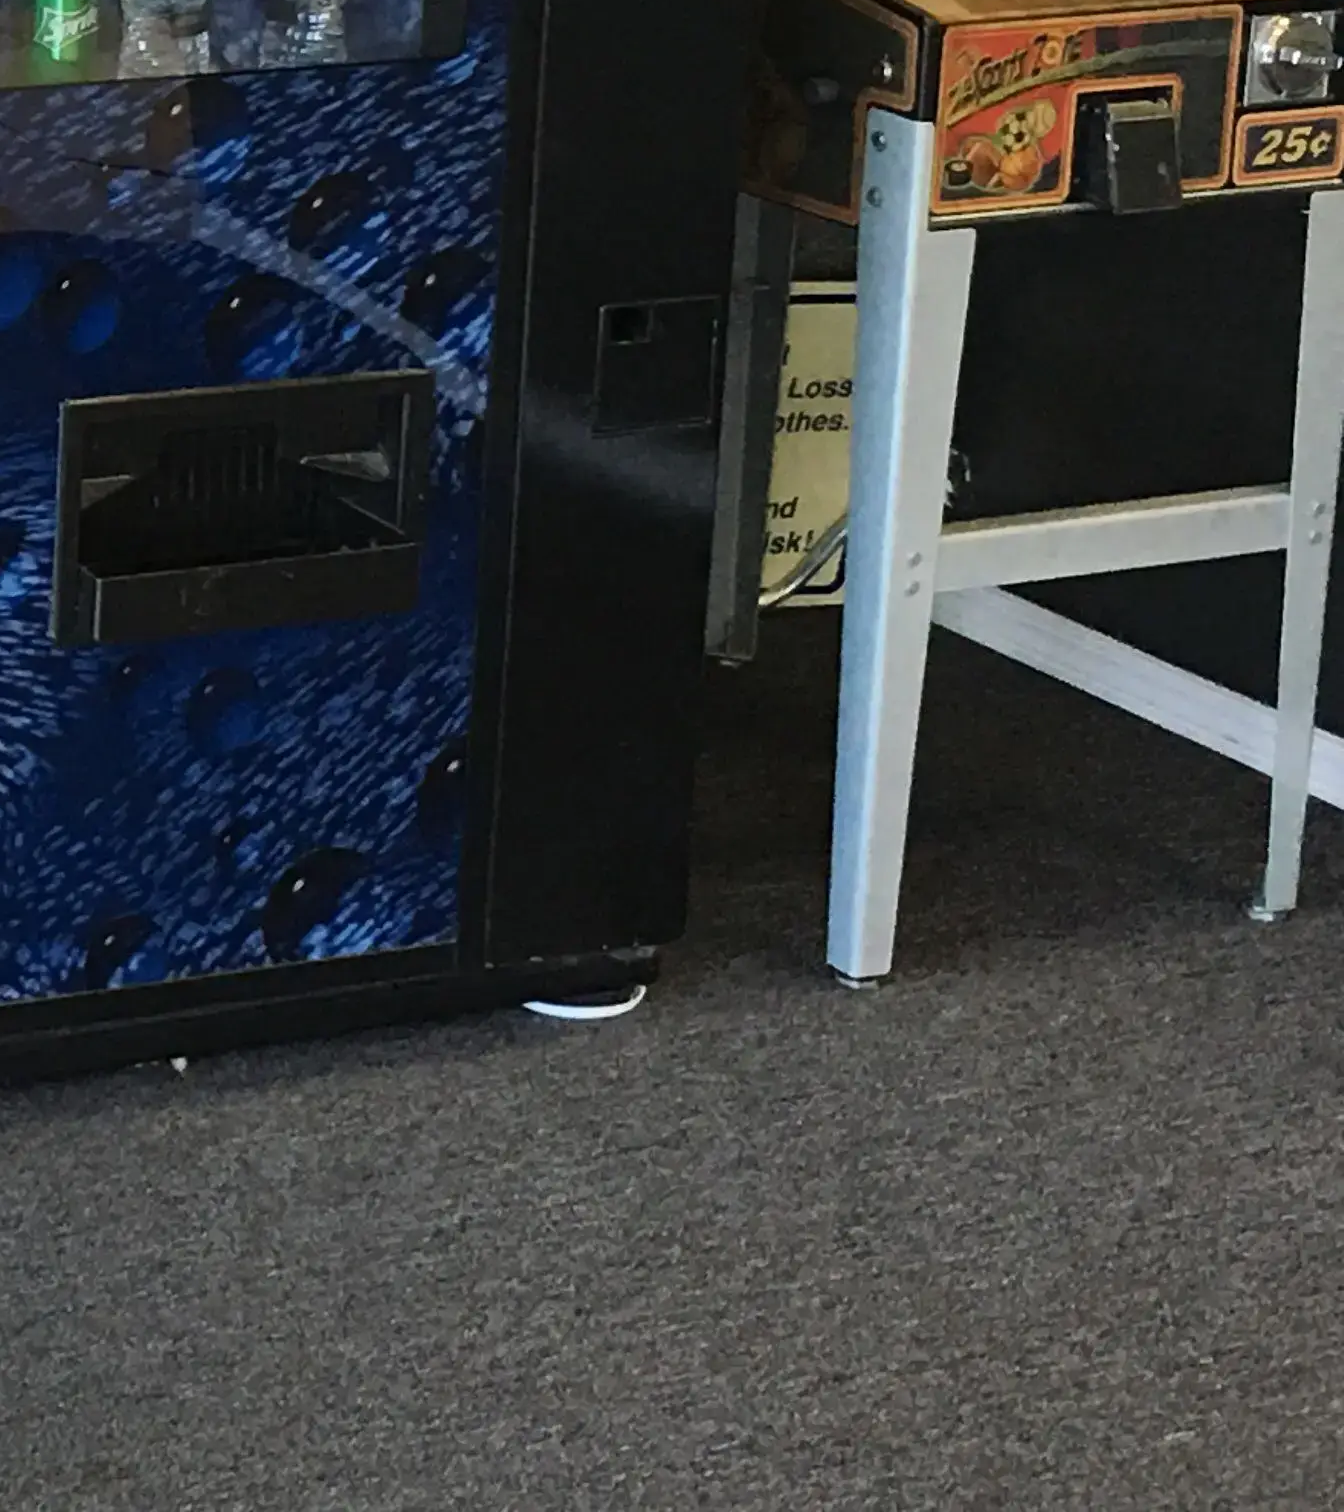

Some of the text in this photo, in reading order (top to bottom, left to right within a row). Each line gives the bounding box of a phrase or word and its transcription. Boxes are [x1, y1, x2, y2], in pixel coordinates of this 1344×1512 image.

[1252, 126, 1333, 167] 25¢
[787, 377, 853, 399] Loss
[776, 411, 850, 433] othes.
[766, 497, 797, 521] nd
[764, 529, 813, 555] isk!
